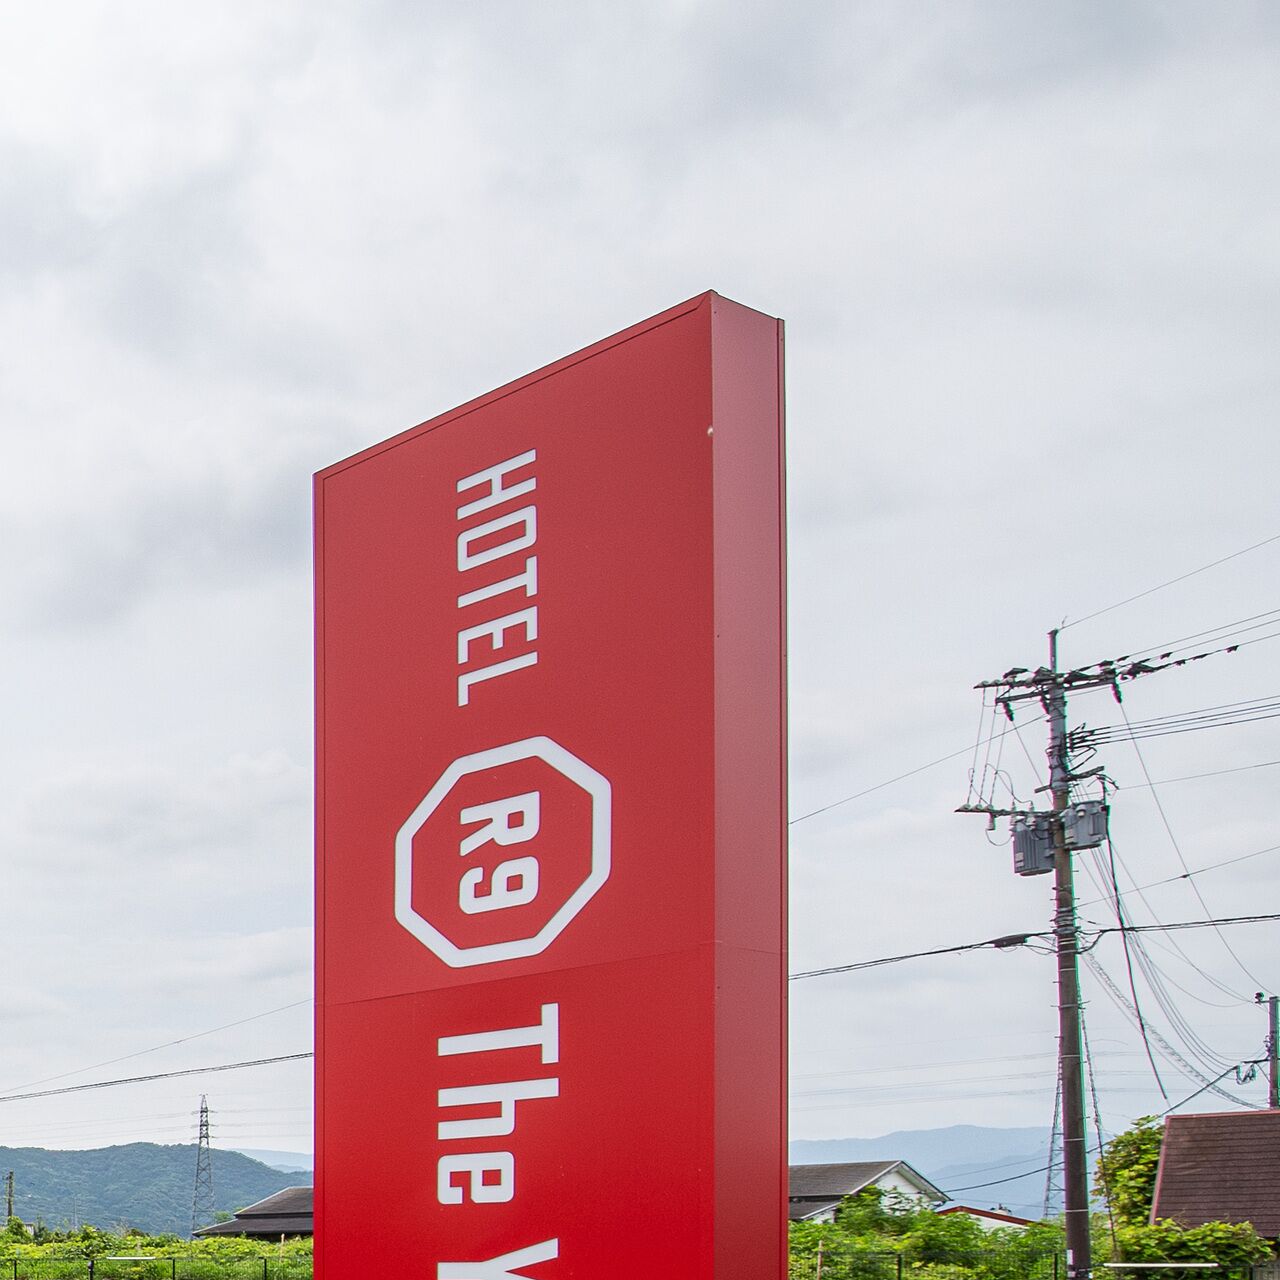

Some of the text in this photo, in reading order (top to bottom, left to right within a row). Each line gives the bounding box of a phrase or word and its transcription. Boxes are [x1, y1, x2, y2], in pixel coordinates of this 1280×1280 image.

[456, 448, 539, 708] HOTEL
[458, 790, 541, 916] R9
[436, 1002, 560, 1206] The
